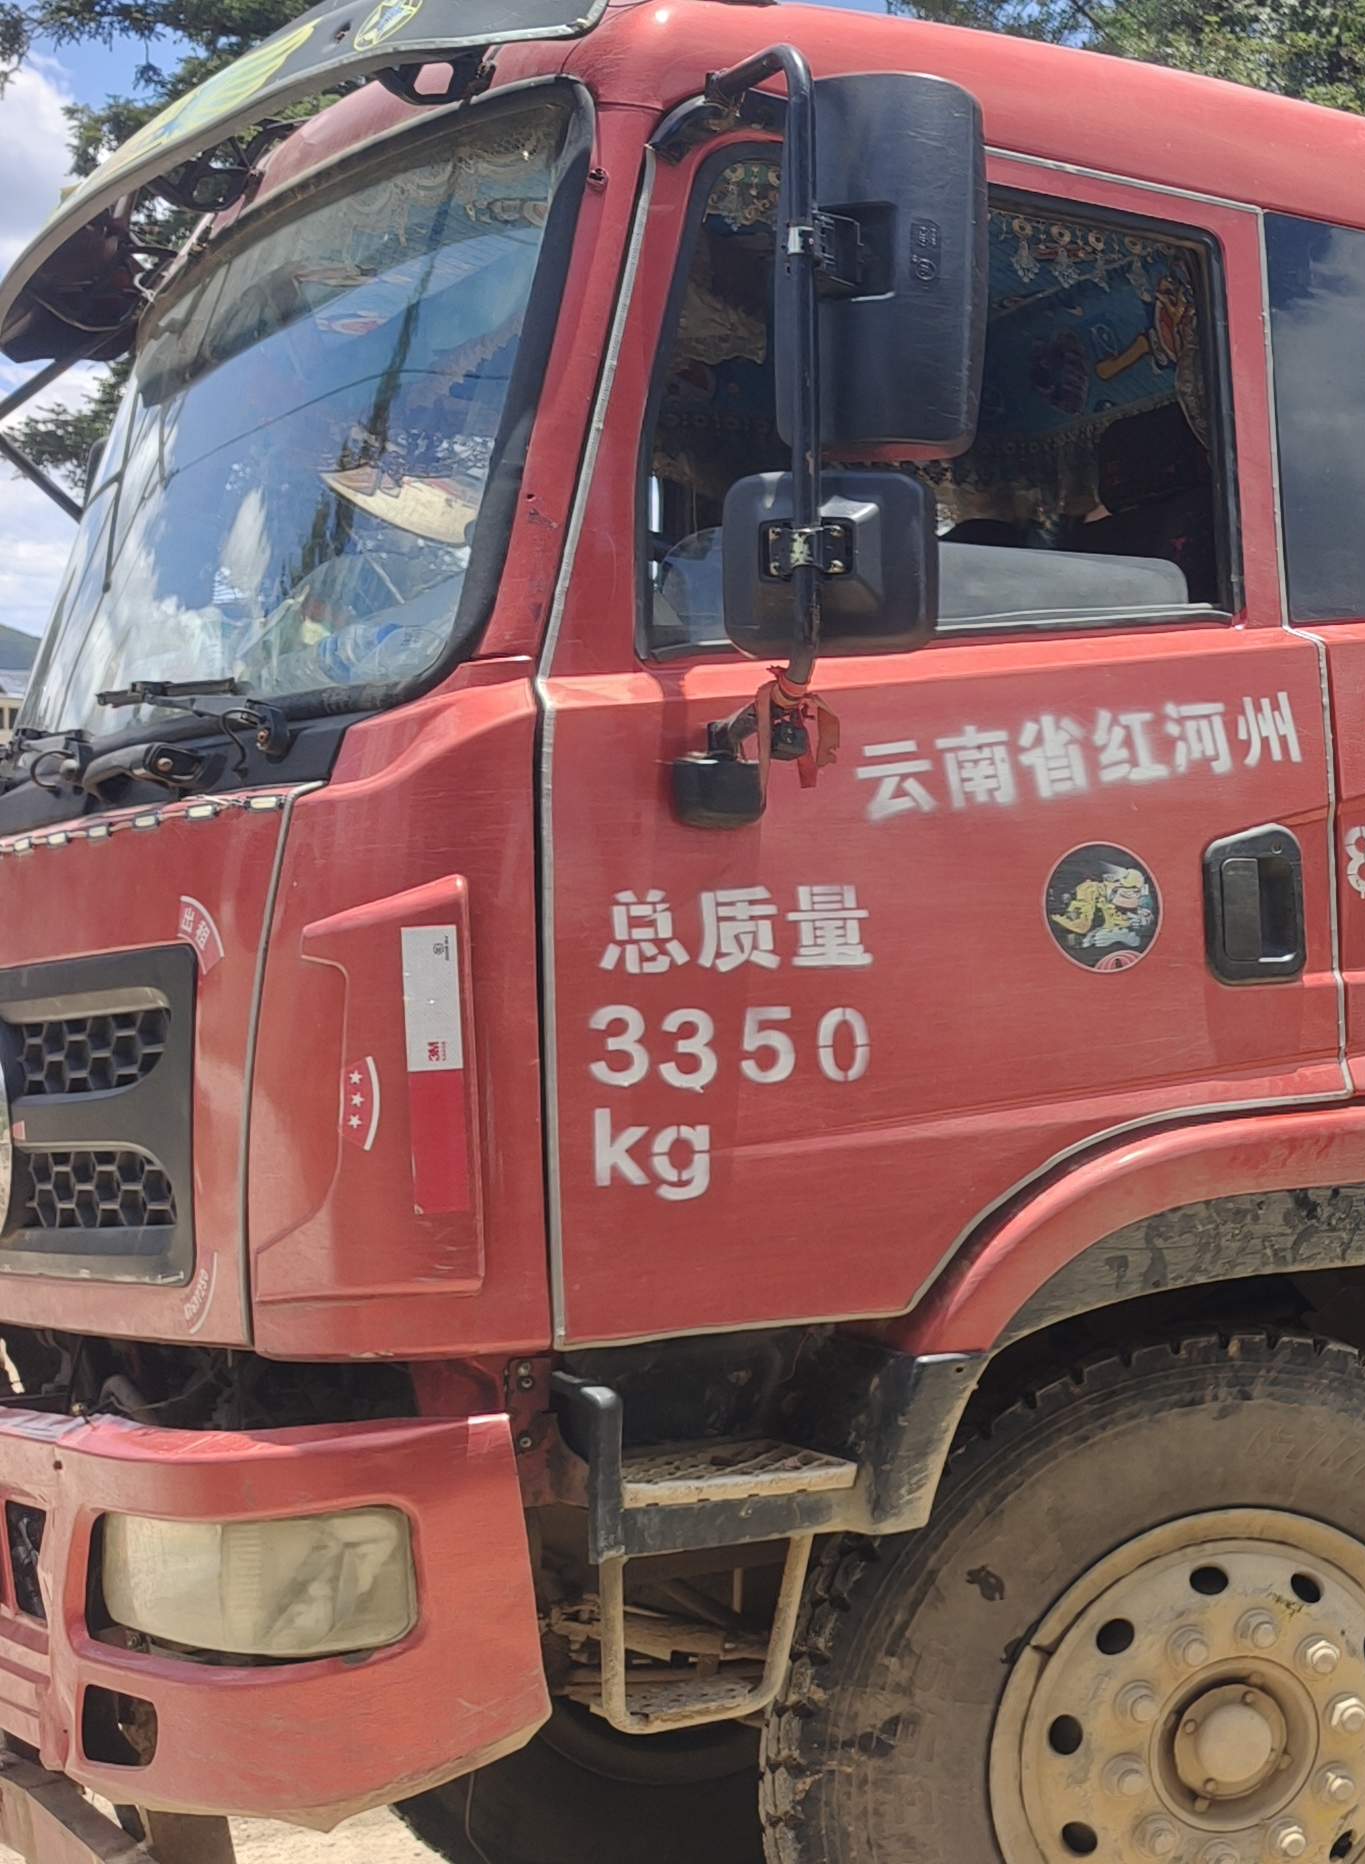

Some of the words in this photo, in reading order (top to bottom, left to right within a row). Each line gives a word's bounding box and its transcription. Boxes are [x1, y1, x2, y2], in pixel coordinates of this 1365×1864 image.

[855, 691, 1302, 821] 云南省红河州
[598, 883, 873, 974] 总质量
[588, 1004, 871, 1092] 3350
[593, 1108, 711, 1200] kg
